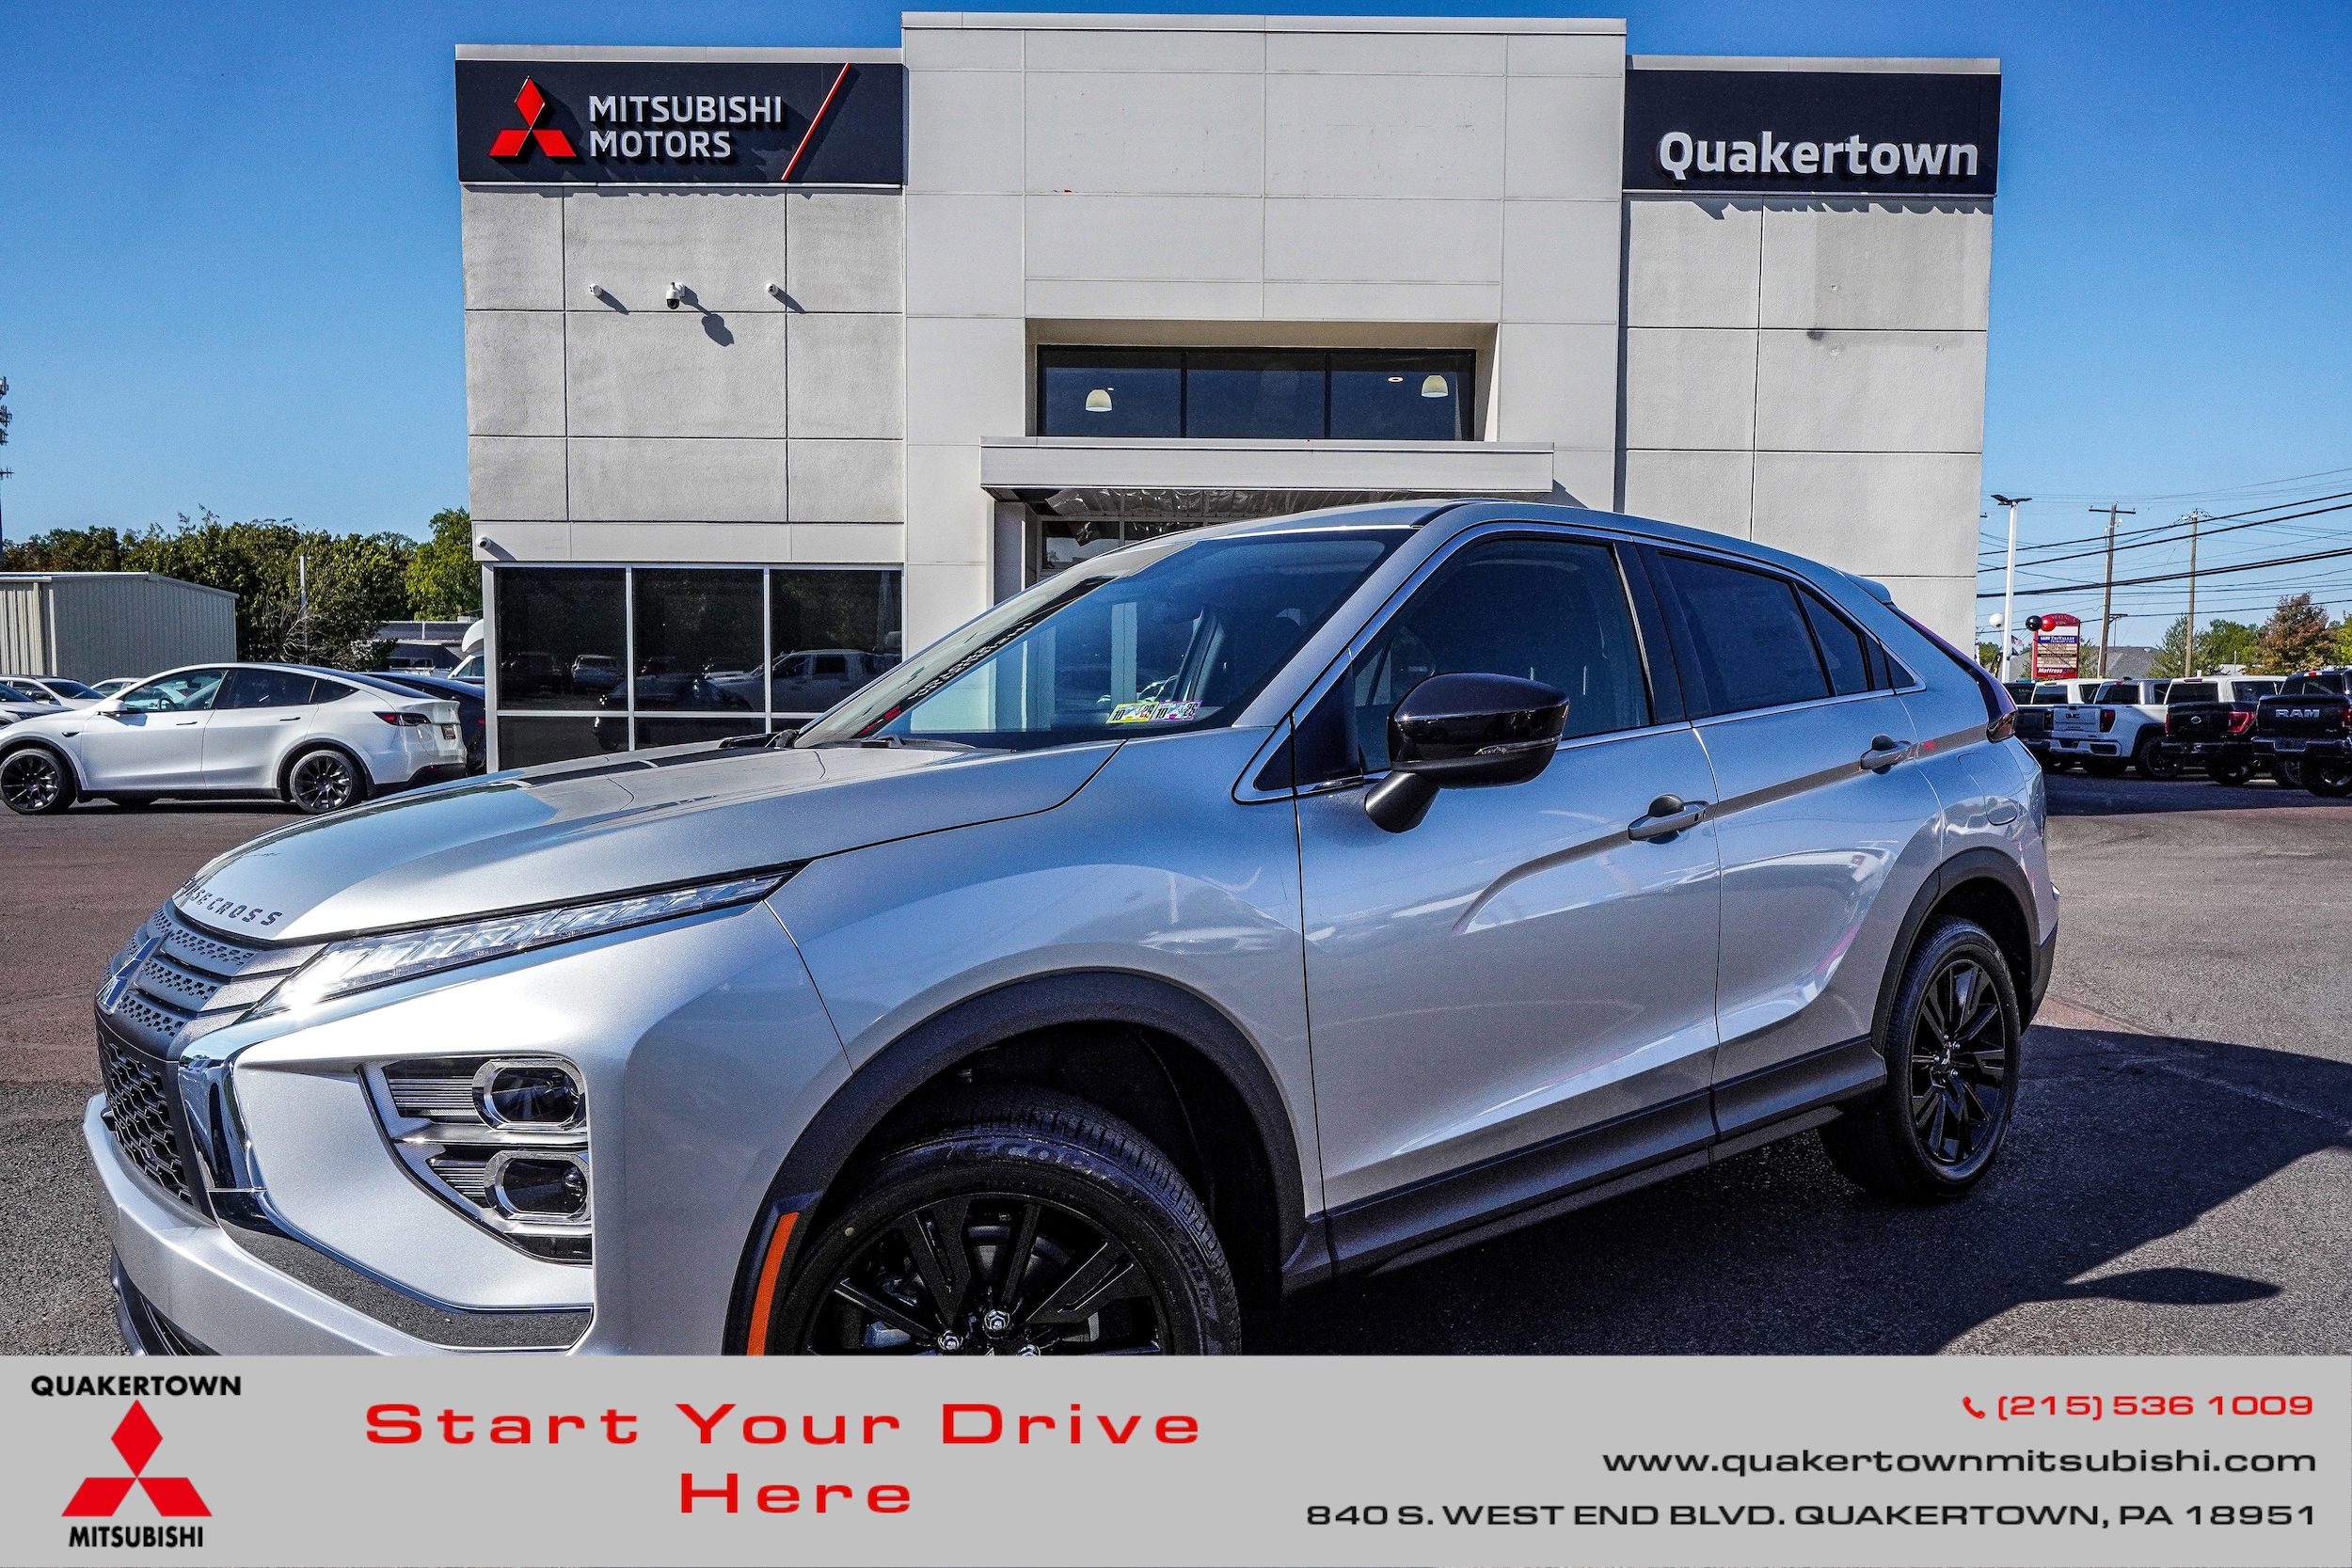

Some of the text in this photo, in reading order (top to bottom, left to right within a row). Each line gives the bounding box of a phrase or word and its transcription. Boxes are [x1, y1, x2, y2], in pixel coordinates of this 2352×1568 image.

[588, 95, 782, 123] MITSUBISHI
[589, 129, 731, 158] MOTORS
[1659, 130, 1979, 181] Quakertown
[2275, 709, 2320, 718] RAM
